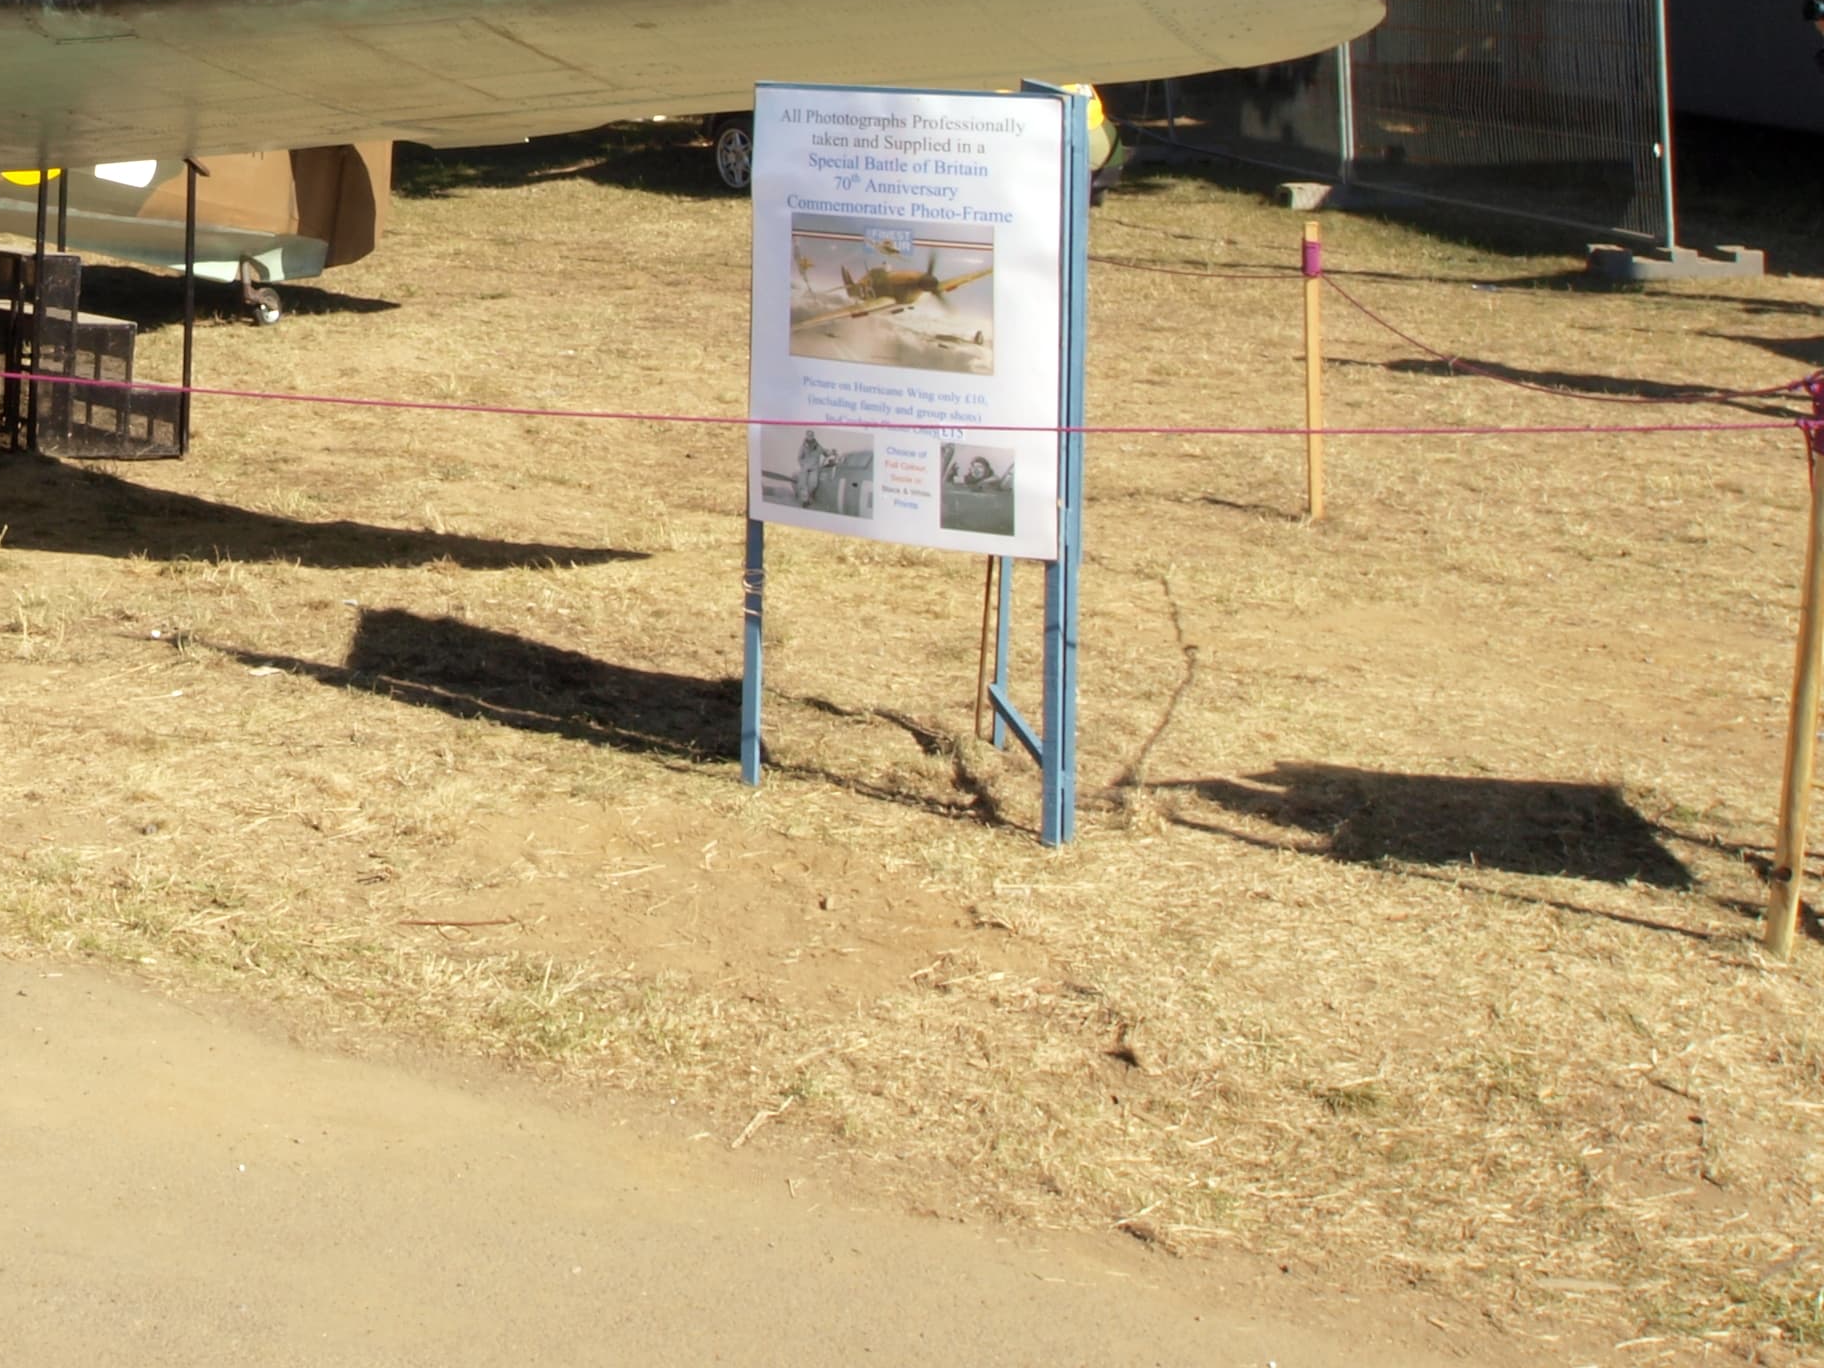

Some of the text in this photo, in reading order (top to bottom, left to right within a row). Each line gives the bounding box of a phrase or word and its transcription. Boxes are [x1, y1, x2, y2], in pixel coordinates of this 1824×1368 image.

[780, 108, 802, 124] All
[912, 114, 1026, 137] Professionally
[811, 131, 986, 155] taken and Supplied in a
[808, 152, 989, 177] Special Battle of Britain
[865, 178, 958, 201] Anniversary
[786, 194, 1014, 224] Commemorative Photo-Frame
[802, 376, 836, 390] Picture
[853, 381, 904, 397] Hurricane
[906, 387, 936, 403] Wing
[938, 391, 961, 404] only
[860, 399, 891, 416] family
[895, 404, 914, 416] and
[917, 408, 946, 421] group
